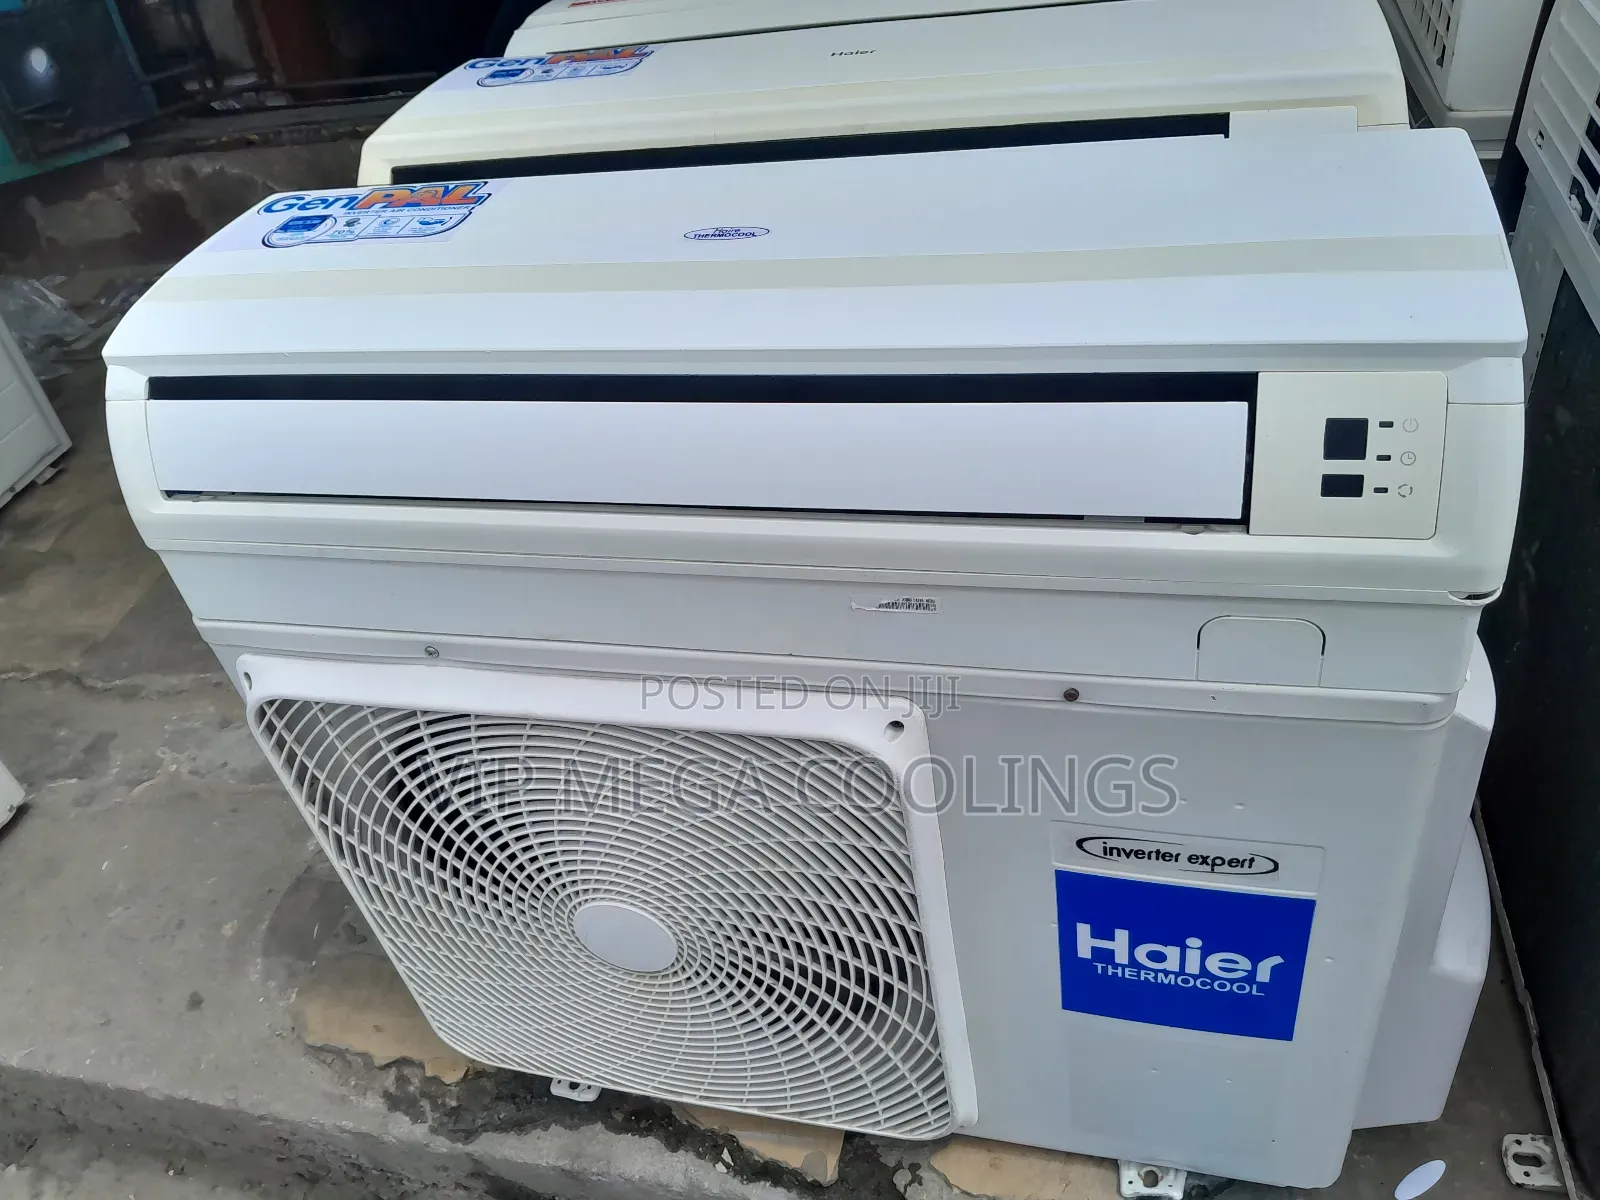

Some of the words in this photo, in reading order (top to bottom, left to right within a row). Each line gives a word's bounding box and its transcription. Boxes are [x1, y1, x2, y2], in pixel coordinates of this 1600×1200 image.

[831, 49, 877, 57] Haier
[258, 180, 491, 215] GenPAL
[406, 204, 471, 213] CONDITIONER
[1102, 841, 1182, 863] inverter
[1187, 853, 1256, 873] expert
[1076, 922, 1285, 983] Haier
[1092, 962, 1266, 997] THERMOCOOL
